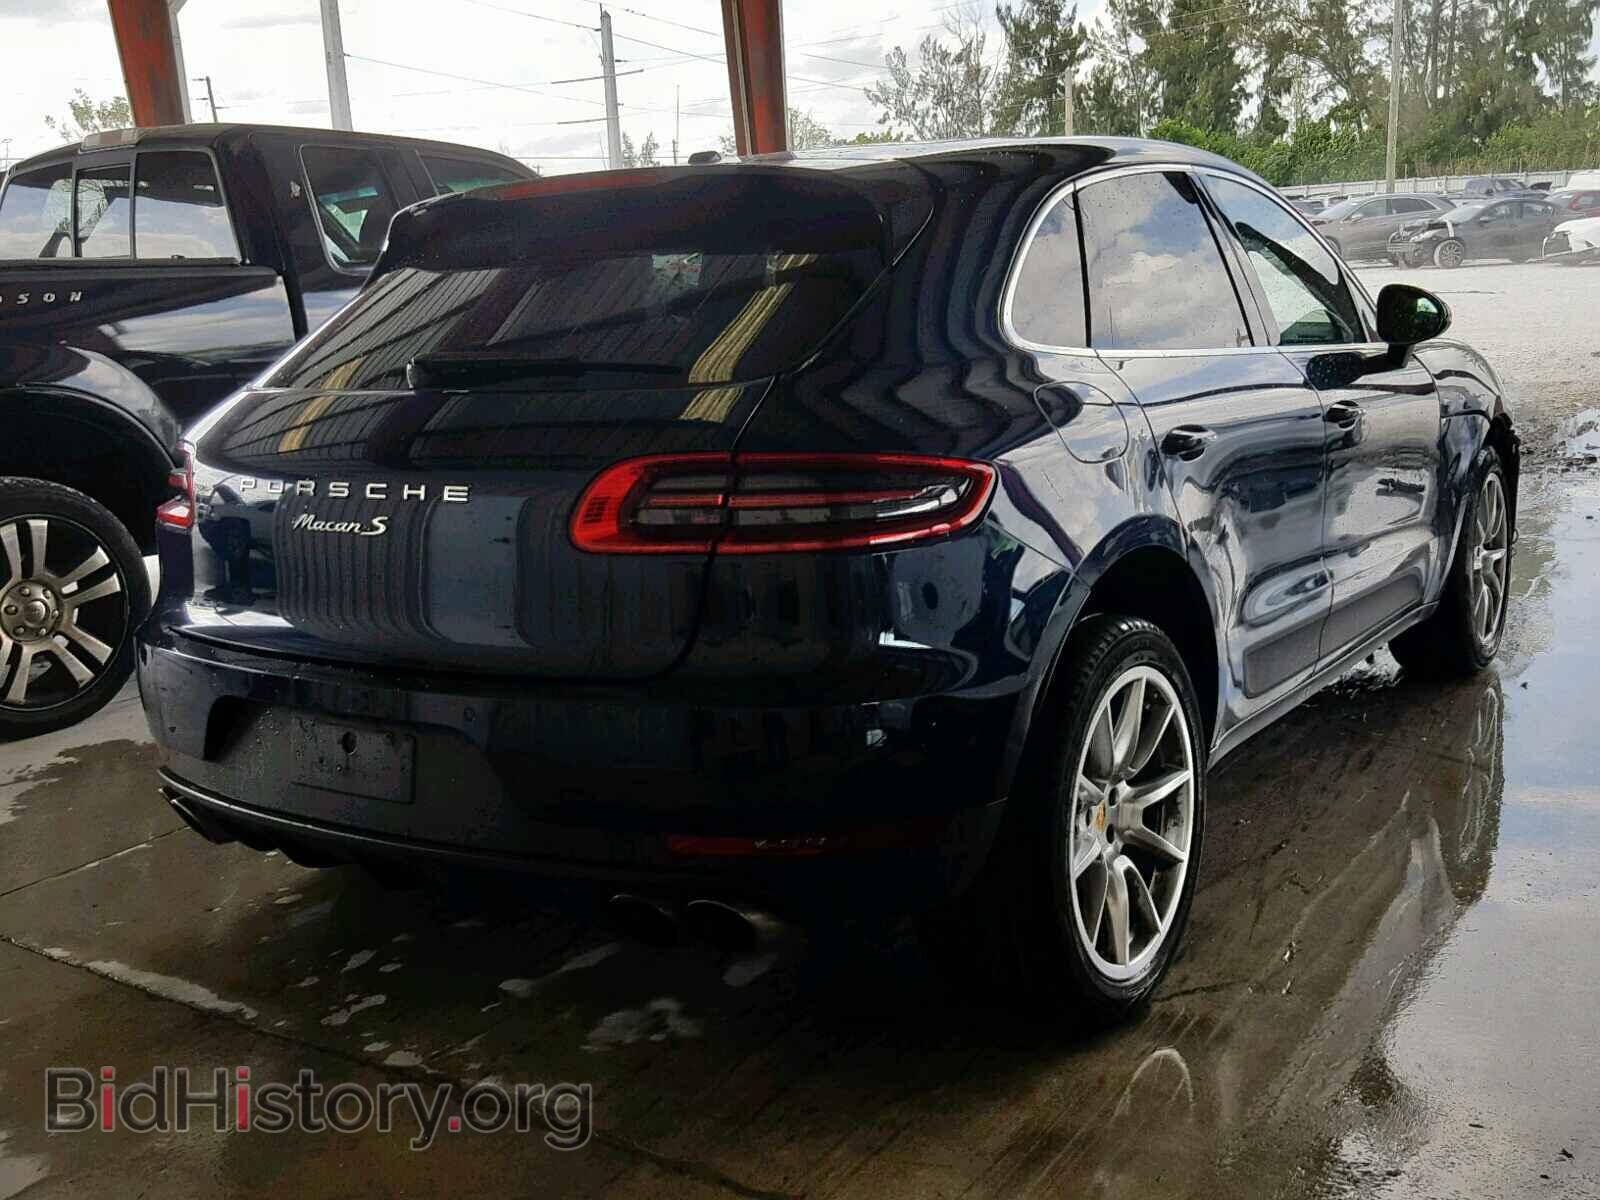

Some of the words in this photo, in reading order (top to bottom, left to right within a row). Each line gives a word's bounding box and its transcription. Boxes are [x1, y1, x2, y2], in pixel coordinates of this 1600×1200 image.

[0, 292, 82, 304] SON
[239, 479, 470, 502] PORSCHE
[292, 513, 361, 533] Macan
[361, 516, 389, 536] S
